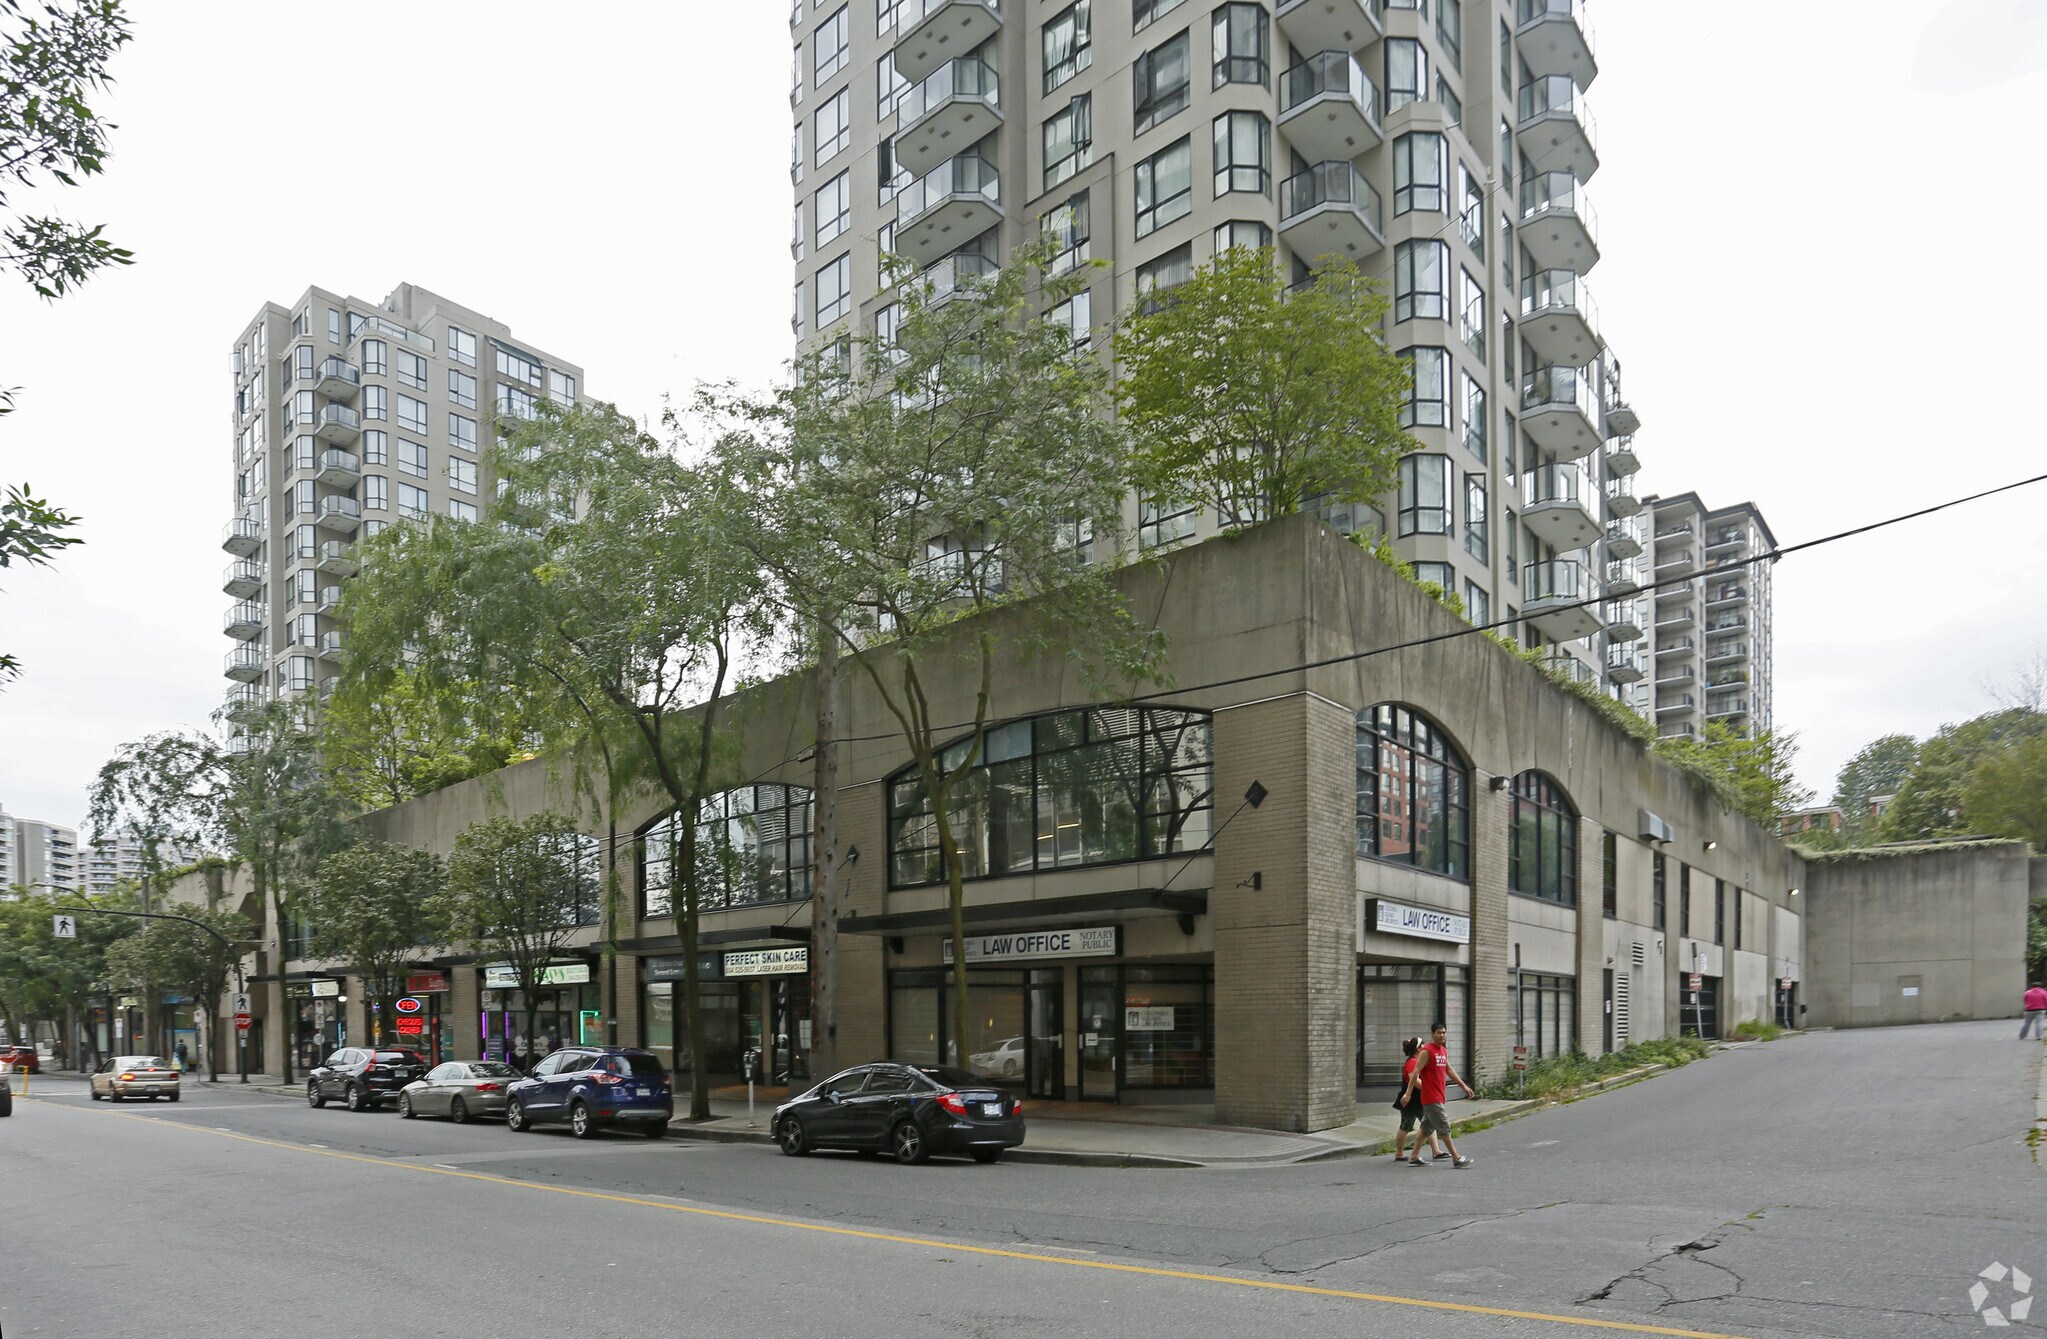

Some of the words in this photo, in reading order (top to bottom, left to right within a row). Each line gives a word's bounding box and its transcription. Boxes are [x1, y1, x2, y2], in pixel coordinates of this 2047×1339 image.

[1403, 909, 1420, 928] LAW
[1422, 913, 1450, 933] OFFICE
[1080, 930, 1114, 941] NOTARY
[983, 938, 1013, 955] LAW
[1016, 933, 1071, 953] OFFICE
[1082, 939, 1112, 950] PUBLIC
[725, 953, 760, 966] PERFECT
[761, 951, 782, 964] SKIN
[783, 950, 806, 962] CARE
[757, 964, 771, 972] LASER
[784, 962, 806, 971] REMOVAL
[398, 1000, 418, 1010] OPEN
[235, 1017, 251, 1025] STOP
